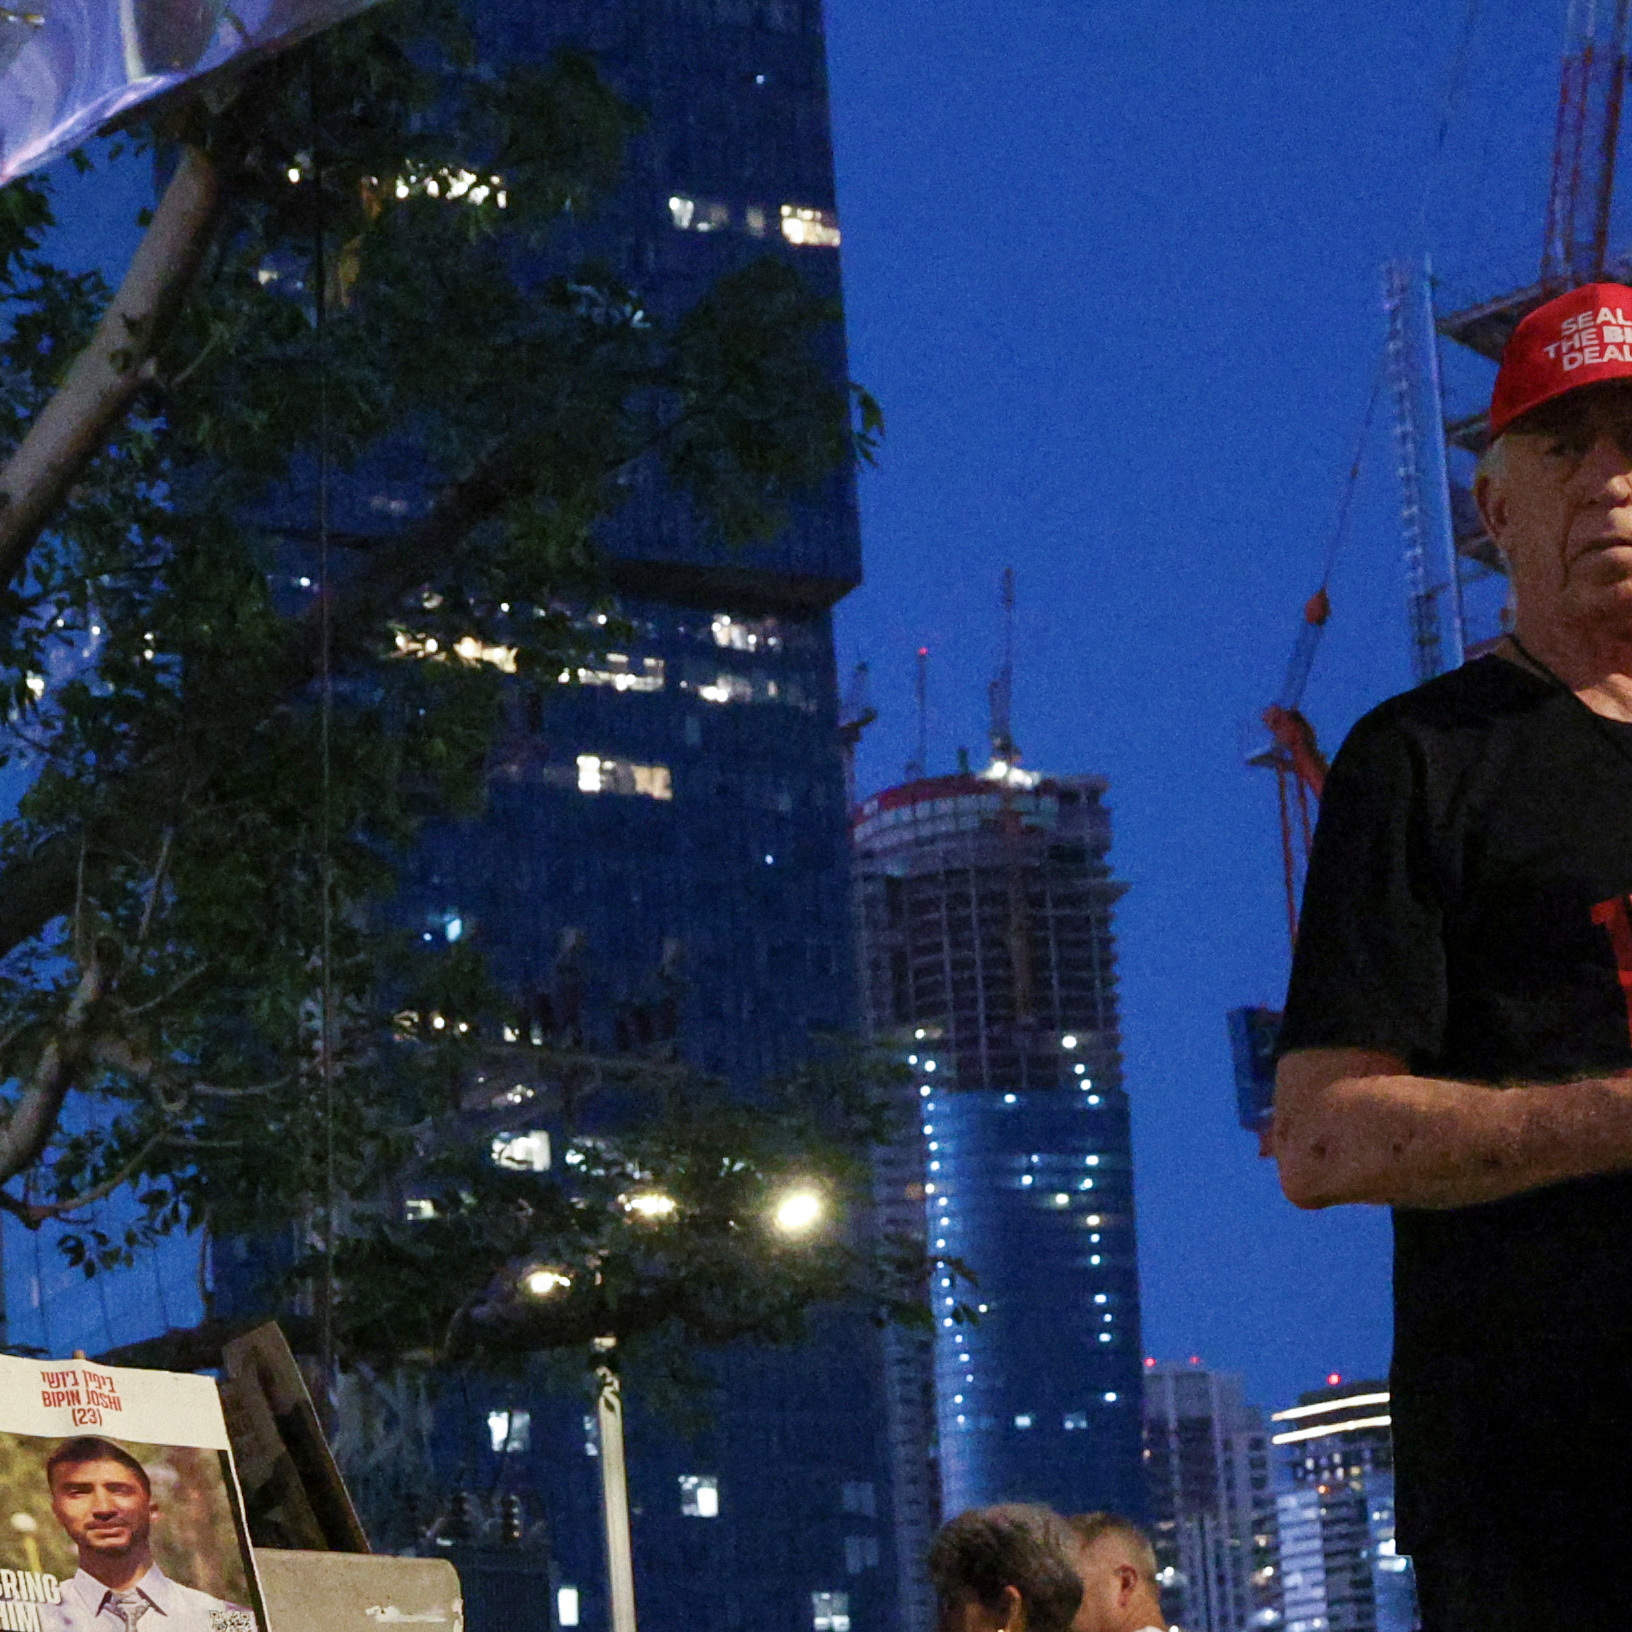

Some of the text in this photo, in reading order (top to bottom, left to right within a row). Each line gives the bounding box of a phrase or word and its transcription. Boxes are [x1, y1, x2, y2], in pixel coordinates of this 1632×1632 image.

[1561, 307, 1632, 336] SEAL
[1544, 328, 1599, 358] THE
[41, 1389, 122, 1411] BIPIN JOSHI
[71, 1408, 102, 1427] (23)
